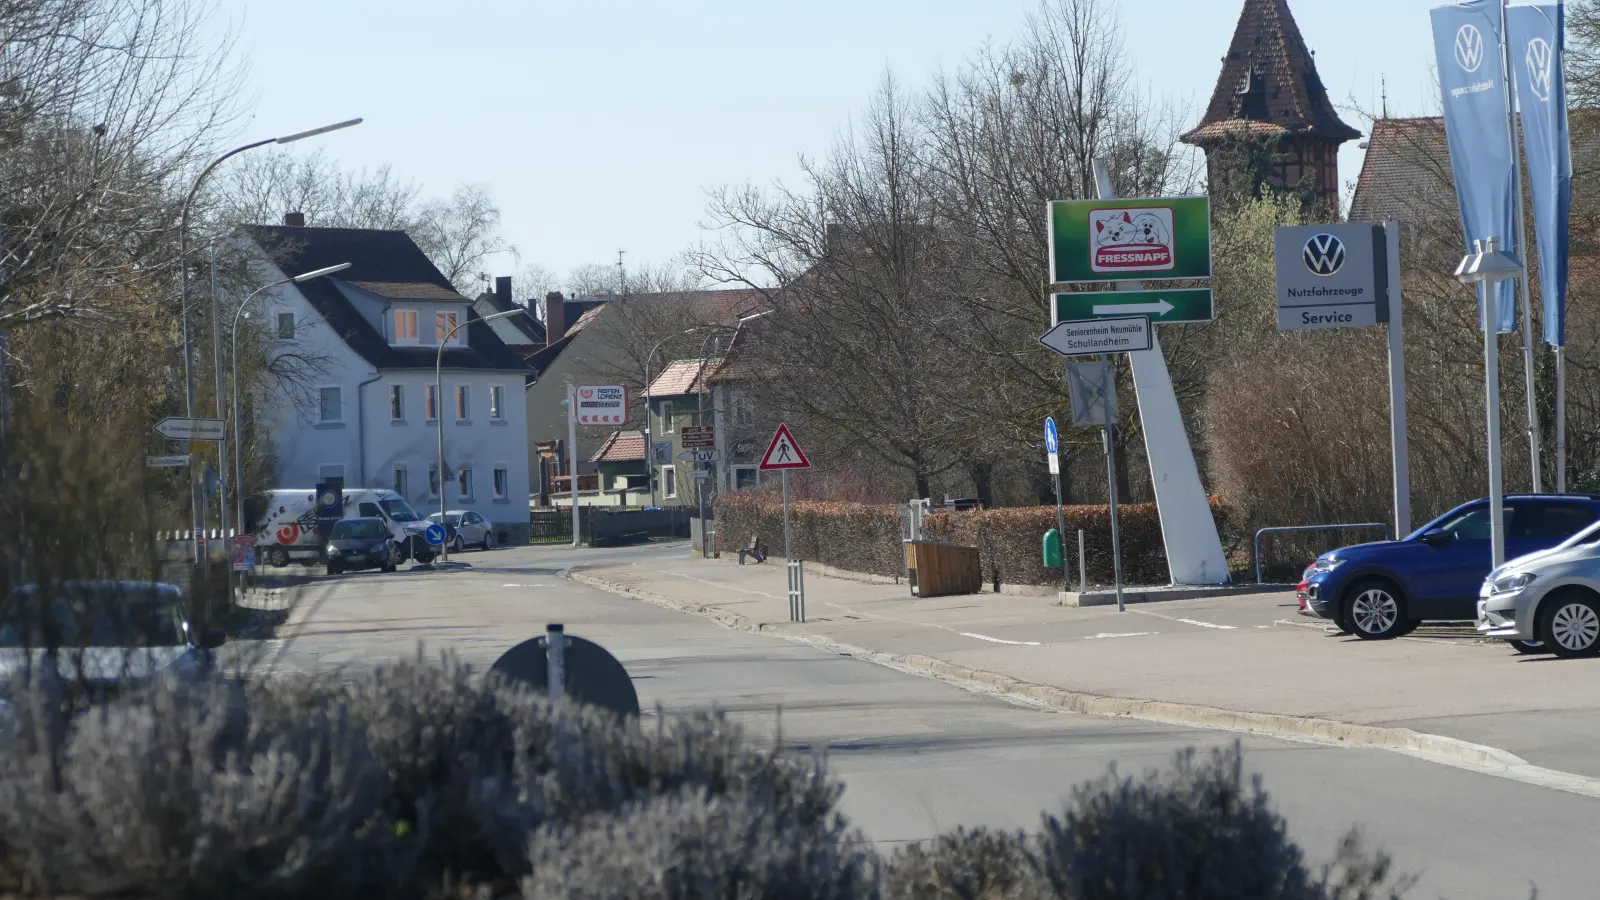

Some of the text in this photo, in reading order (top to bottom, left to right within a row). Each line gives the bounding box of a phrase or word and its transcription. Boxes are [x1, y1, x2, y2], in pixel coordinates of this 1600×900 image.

[1097, 252, 1168, 264] FRESSNAPF
[1303, 233, 1345, 275] VW
[1287, 286, 1364, 298] Nutzfahrzeuge
[1301, 311, 1353, 325] Service
[1066, 324, 1142, 337] Seniorenheim Neumühle
[1067, 337, 1130, 349] Schullandheim
